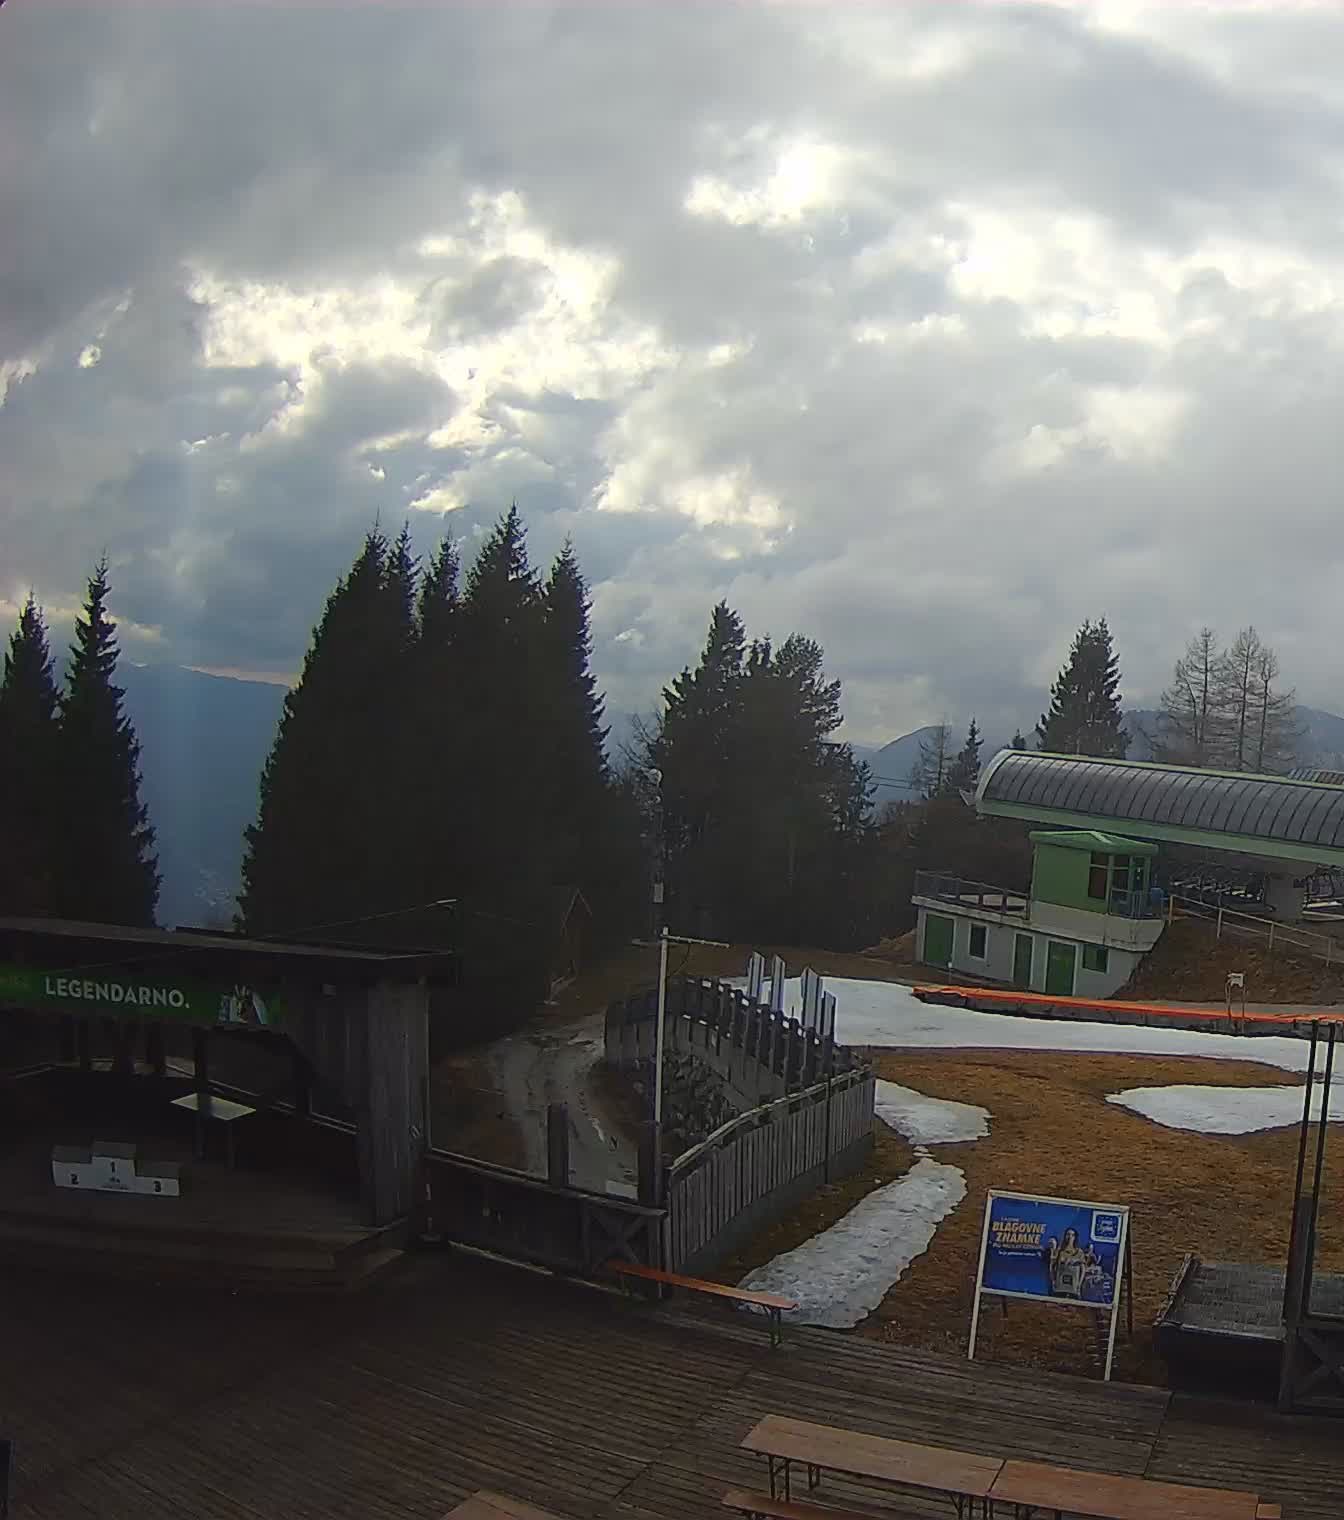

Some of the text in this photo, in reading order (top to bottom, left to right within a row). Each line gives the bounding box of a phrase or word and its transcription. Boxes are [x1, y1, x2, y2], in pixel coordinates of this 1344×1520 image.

[45, 976, 190, 1009] LEGENDARNO.
[70, 1173, 79, 1185] 2
[153, 1181, 162, 1193] 3
[992, 1221, 1047, 1234] BLAGOVNE
[996, 1232, 1041, 1245] ZNAMKE
